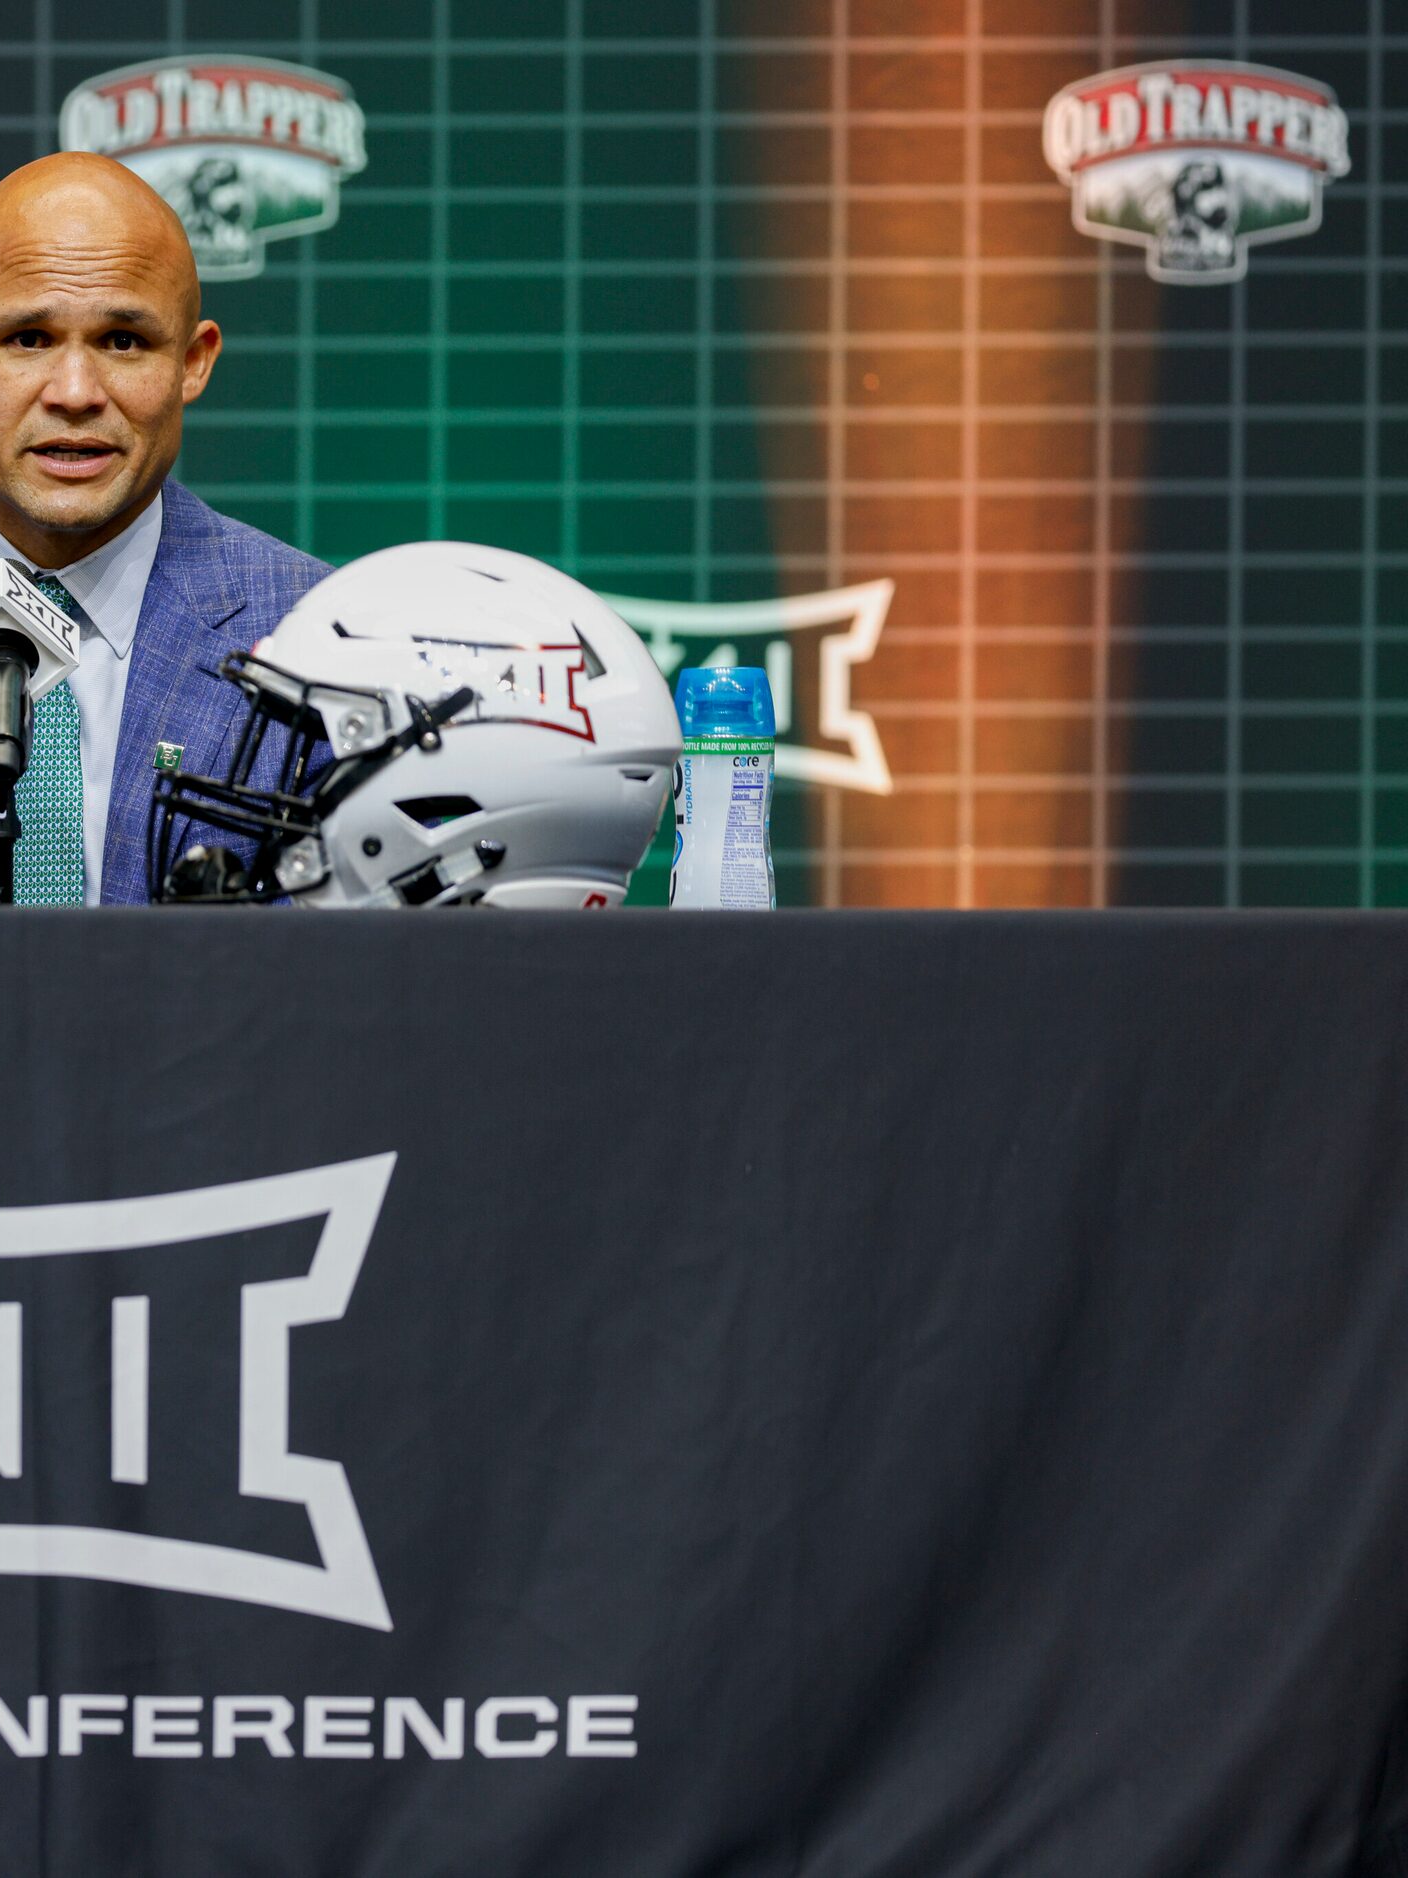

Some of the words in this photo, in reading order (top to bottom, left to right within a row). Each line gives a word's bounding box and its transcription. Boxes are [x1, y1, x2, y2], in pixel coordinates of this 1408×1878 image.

[153, 68, 368, 173] TRAPPER
[1045, 93, 1141, 172] OLD
[1137, 72, 1350, 177] TRAPPER
[701, 742, 720, 751] MADE
[721, 742, 737, 751] FROM
[733, 756, 760, 767] core
[685, 759, 693, 825] HYDRATION
